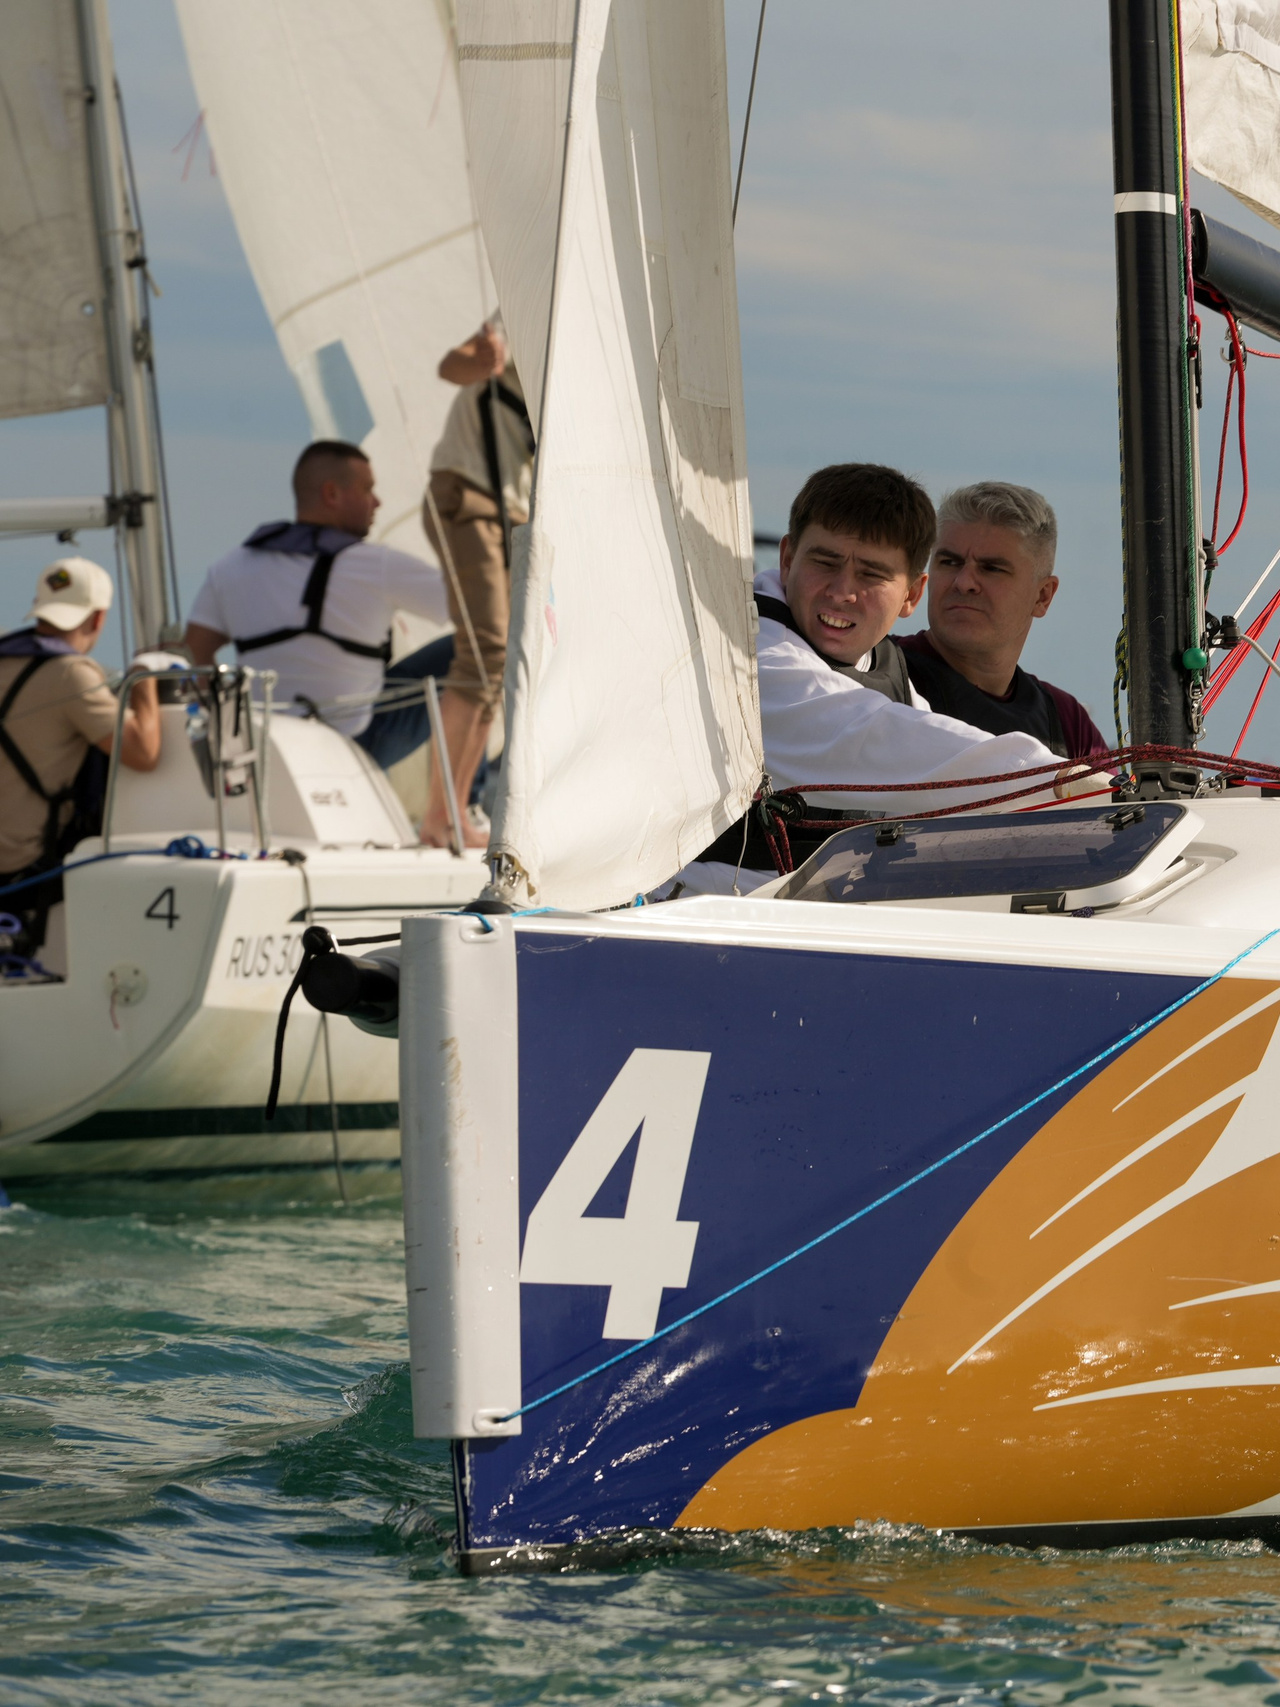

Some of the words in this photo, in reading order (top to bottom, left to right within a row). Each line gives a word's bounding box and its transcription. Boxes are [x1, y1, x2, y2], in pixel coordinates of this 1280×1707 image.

[145, 886, 180, 930] 4
[225, 935, 274, 978] RUS
[519, 1047, 712, 1340] 4
